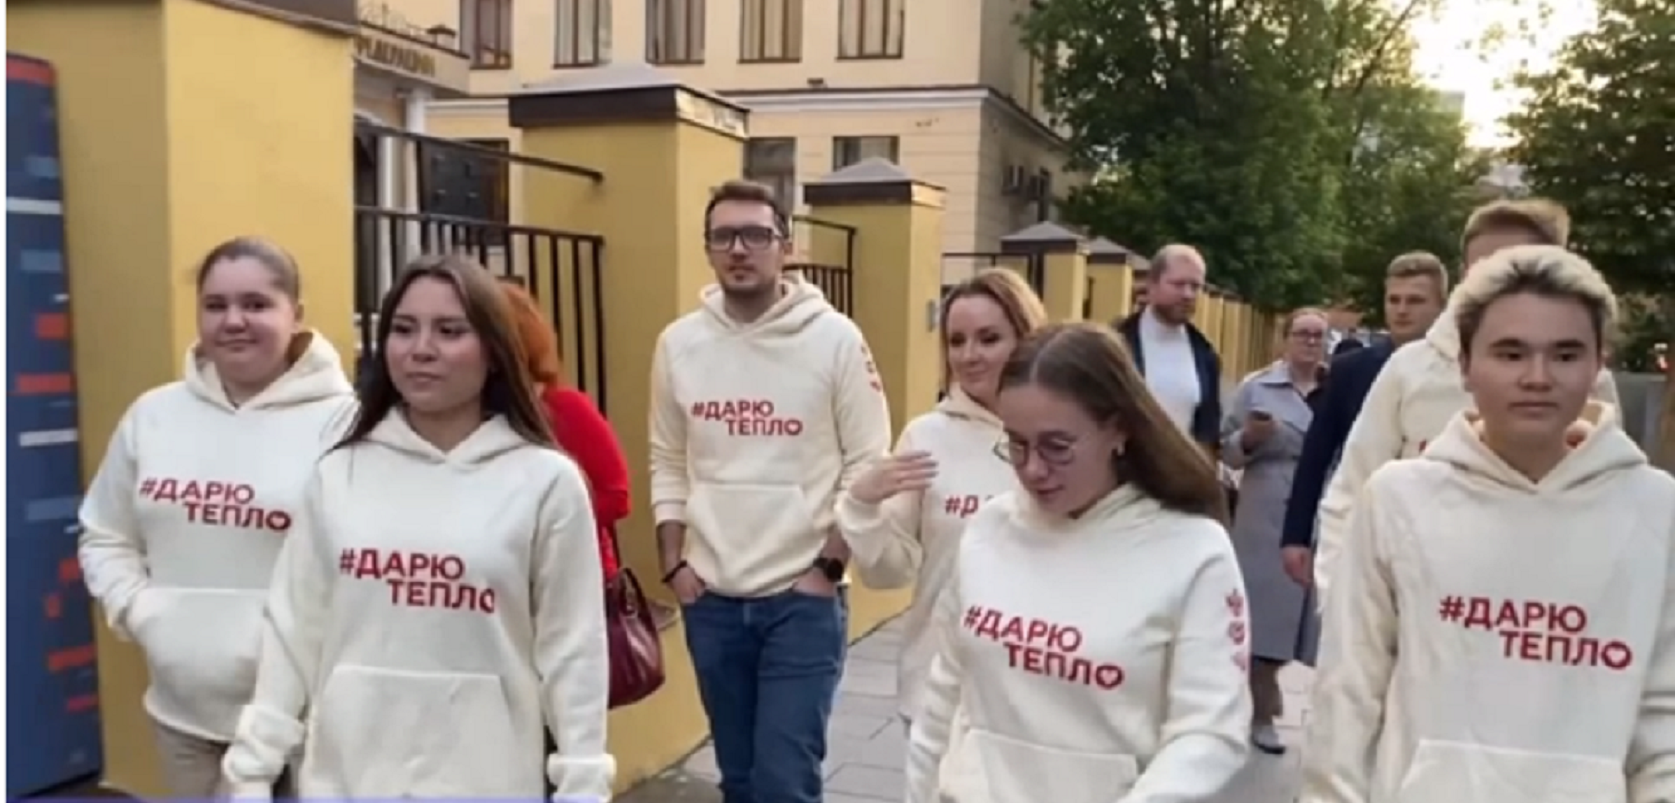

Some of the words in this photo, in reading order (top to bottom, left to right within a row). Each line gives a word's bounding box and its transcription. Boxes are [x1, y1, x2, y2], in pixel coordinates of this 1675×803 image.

[691, 400, 774, 421] #ДАРЮ
[725, 418, 803, 436] ТЕПЛО
[139, 477, 255, 504] #ДАРЮ
[184, 501, 292, 531] ТЕПЛО
[339, 548, 465, 580] #ДАРЮ
[963, 605, 1082, 652] #ДАРЮ
[1439, 595, 1587, 633] #ДАРЮ
[1003, 641, 1125, 690] ТЕПЛО
[1499, 629, 1633, 670] ТЕПЛО
